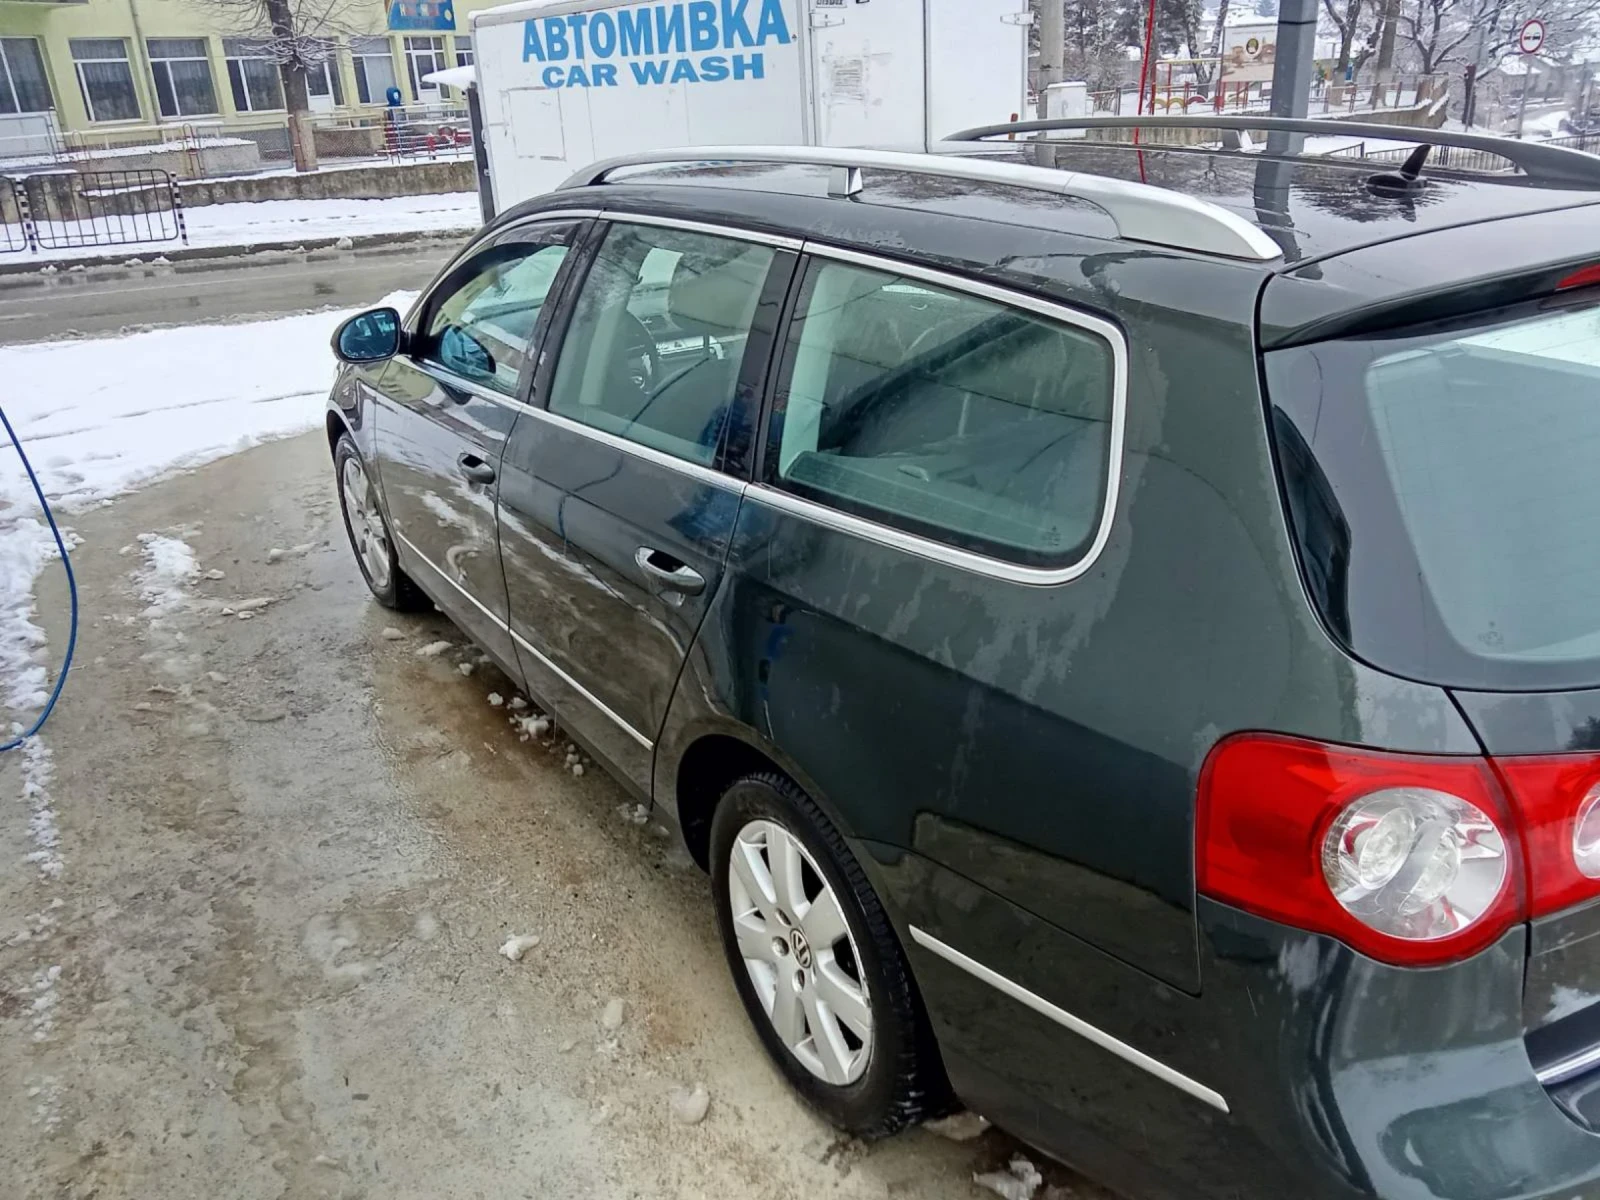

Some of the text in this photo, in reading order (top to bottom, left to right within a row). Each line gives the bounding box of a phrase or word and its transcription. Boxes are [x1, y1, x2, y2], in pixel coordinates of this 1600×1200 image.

[522, 0, 791, 63] АВТОМИВКА
[542, 53, 765, 88] CAR WASH
